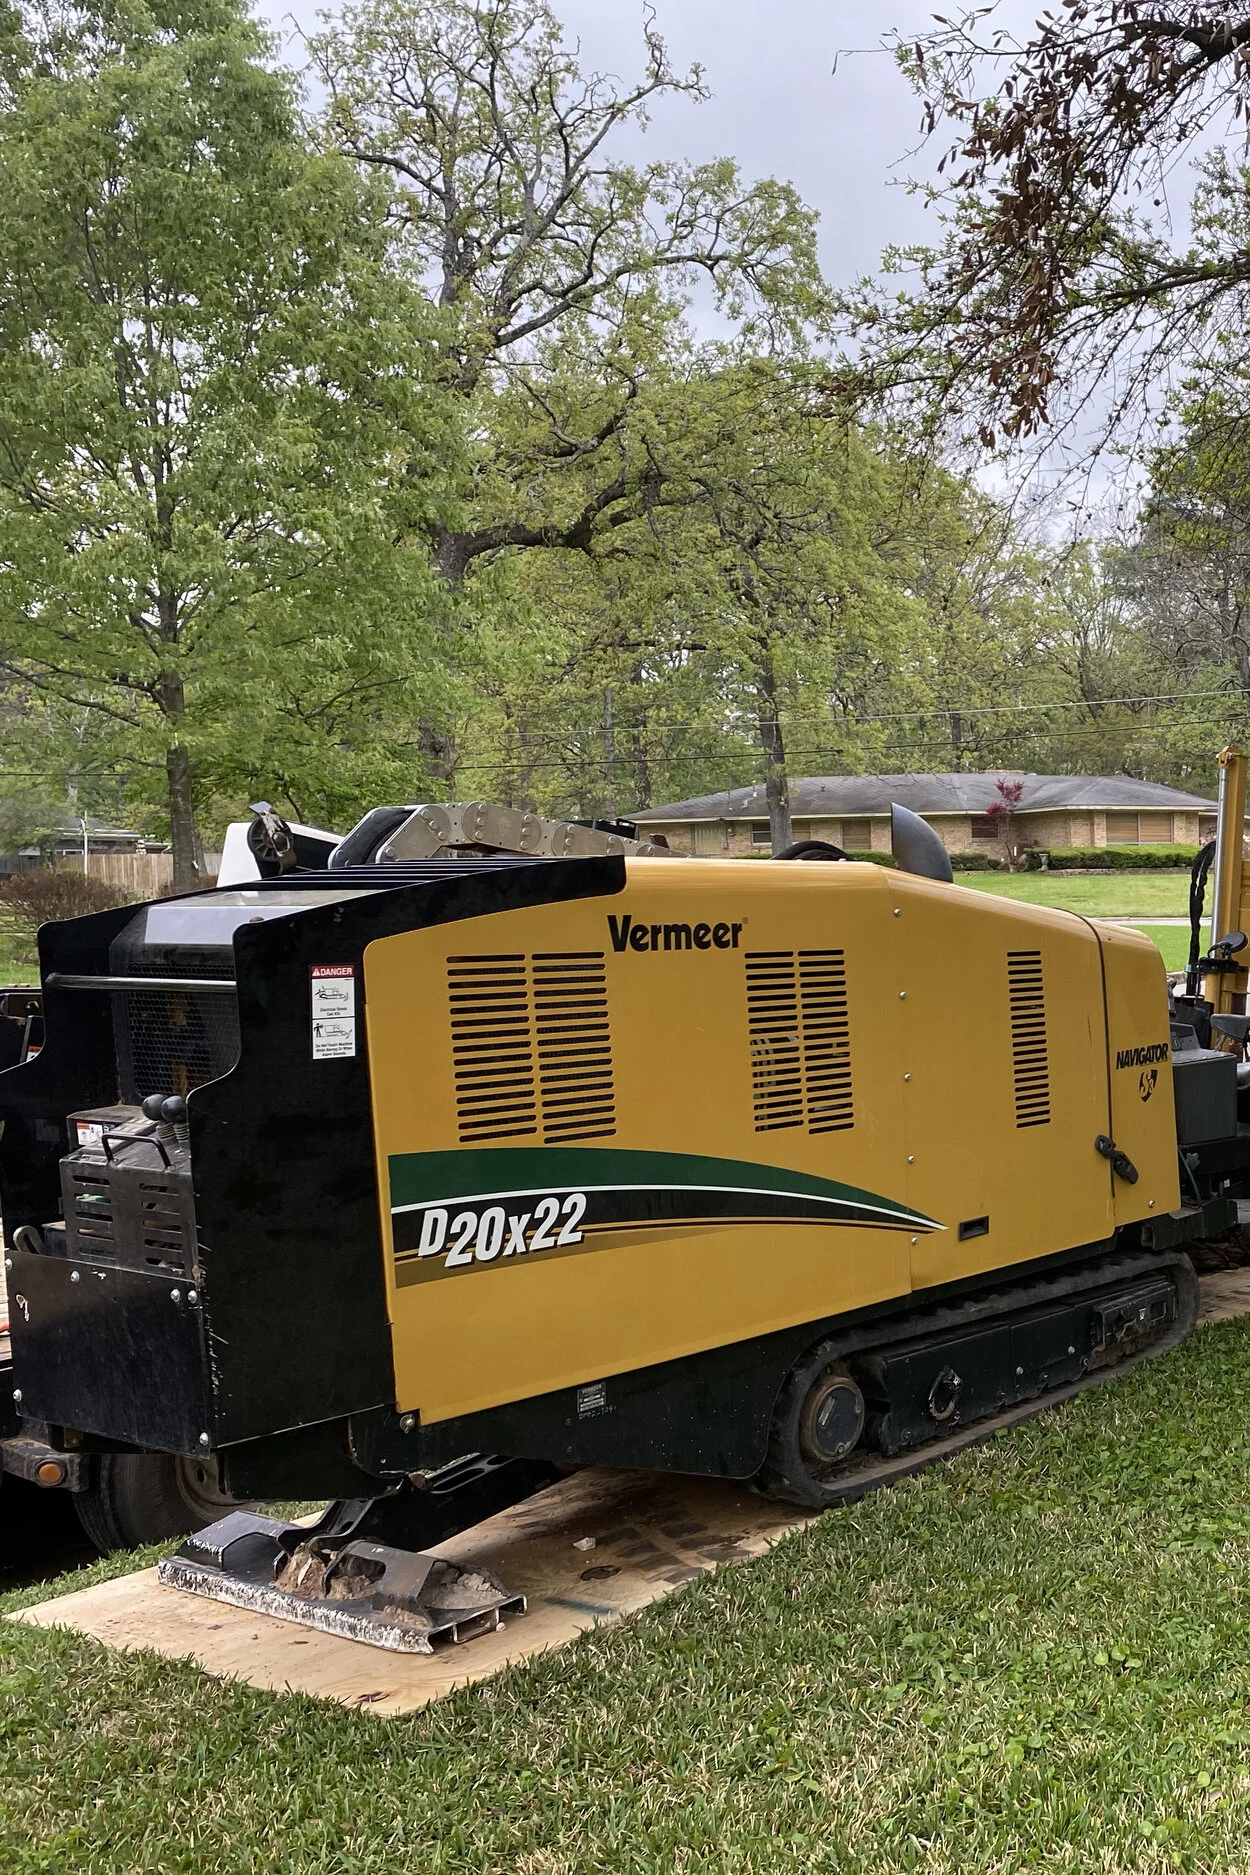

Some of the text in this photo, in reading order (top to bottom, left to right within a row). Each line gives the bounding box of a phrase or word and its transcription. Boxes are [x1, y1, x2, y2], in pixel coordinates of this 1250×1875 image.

[607, 915, 743, 952] Vermeer
[320, 967, 353, 977] DANGER
[1116, 1043, 1168, 1070] NAVIGATOR
[418, 1193, 587, 1267] D20x22
